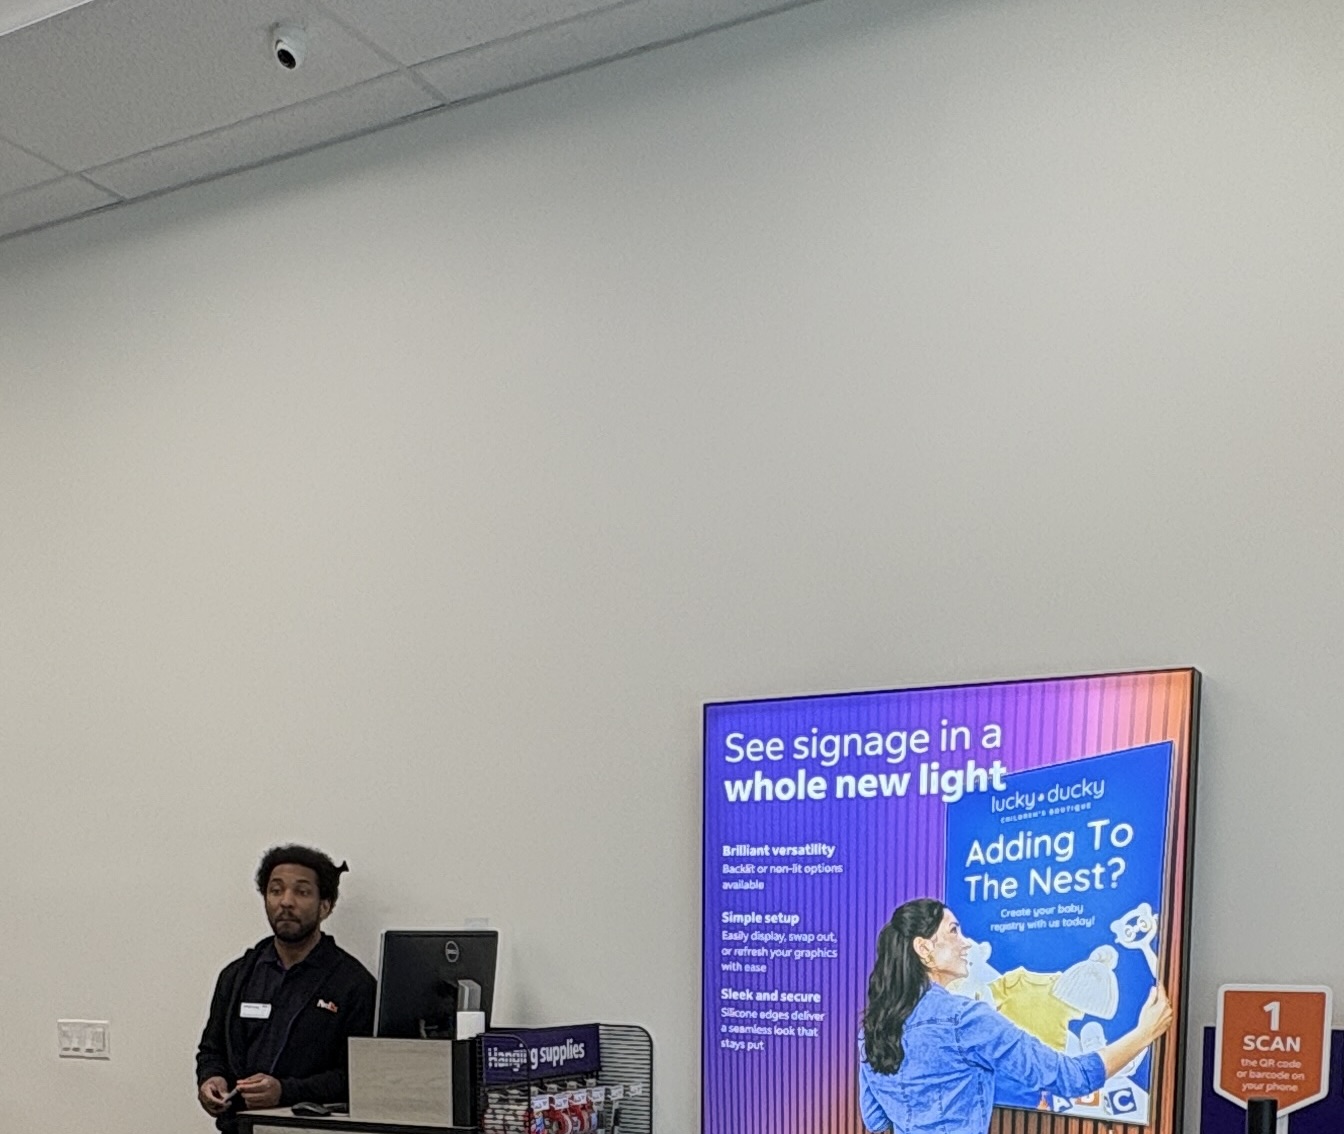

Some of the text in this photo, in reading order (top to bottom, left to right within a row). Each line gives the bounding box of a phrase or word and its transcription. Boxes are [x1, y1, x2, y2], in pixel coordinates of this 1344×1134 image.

[725, 719, 1002, 766] See signage in a
[724, 760, 1007, 802] whole new light
[991, 778, 1105, 813] lucky ducky
[965, 819, 1134, 867] Adding To
[722, 843, 836, 858] Brilliant versatility
[757, 865, 768, 874] or
[769, 863, 803, 874] non-lit
[804, 863, 843, 877] options
[722, 880, 765, 890] available
[964, 857, 1126, 902] The Nest?
[1000, 904, 1084, 919] Create your baby
[721, 912, 800, 926] Simple setup
[1027, 919, 1047, 930] with
[1062, 915, 1096, 927] today!
[750, 931, 787, 944] display,
[789, 932, 815, 943] swap
[816, 932, 837, 943] out,
[769, 948, 793, 958] your
[794, 946, 838, 960] graphics
[721, 961, 743, 972] with
[721, 988, 821, 1003] Sleek and secure
[791, 1009, 825, 1021] deliver
[1263, 1001, 1281, 1031] 1
[773, 1024, 796, 1036] look
[797, 1025, 819, 1037] that
[721, 1039, 765, 1051] stays put
[1242, 1035, 1300, 1052] SCAN
[539, 1038, 585, 1067] supplies
[1260, 1058, 1276, 1068] QR
[1237, 1068, 1305, 1080] or barcode on
[1242, 1082, 1298, 1094] your phone
